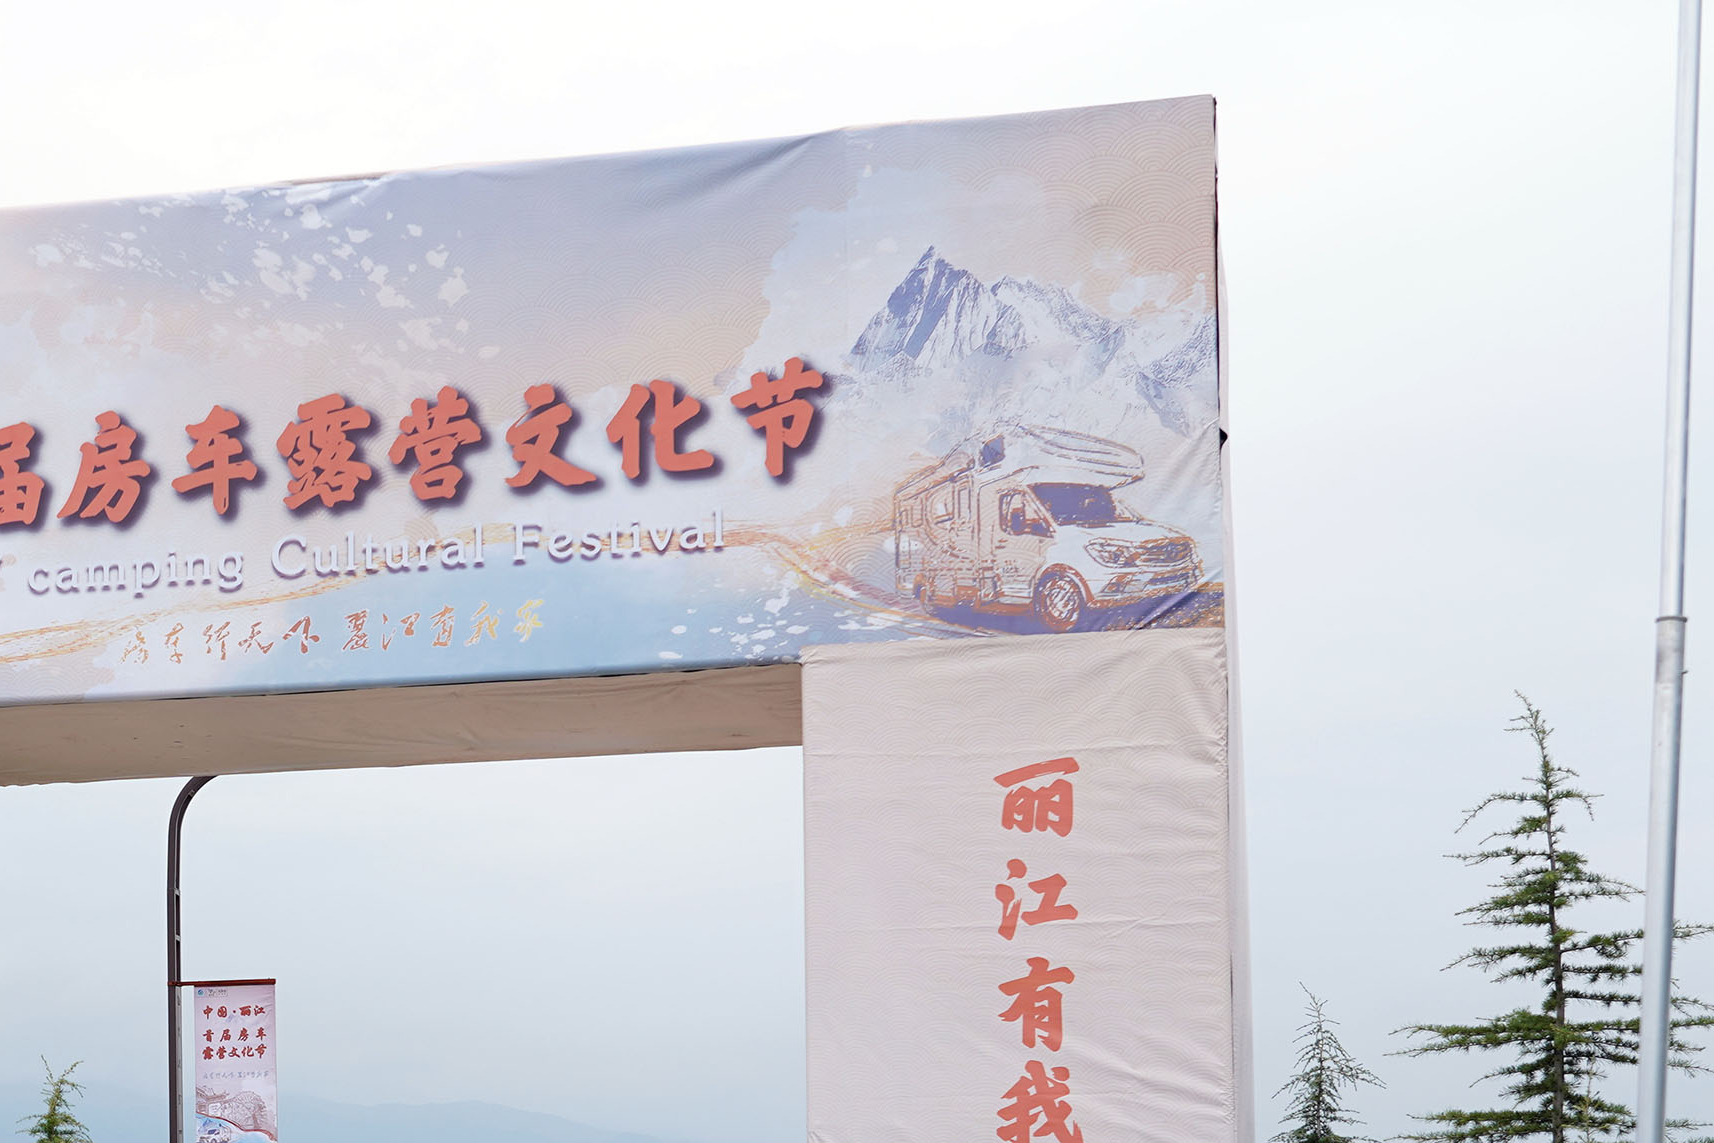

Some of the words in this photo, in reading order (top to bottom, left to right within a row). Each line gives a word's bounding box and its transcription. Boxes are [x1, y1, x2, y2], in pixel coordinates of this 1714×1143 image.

[27, 551, 244, 599] camping
[270, 526, 485, 579] Cultural
[512, 510, 725, 566] Festival
[203, 1005, 265, 1019] 中国·丽江
[203, 1027, 266, 1042] 首届房车
[202, 1044, 267, 1060] 露营文化节
